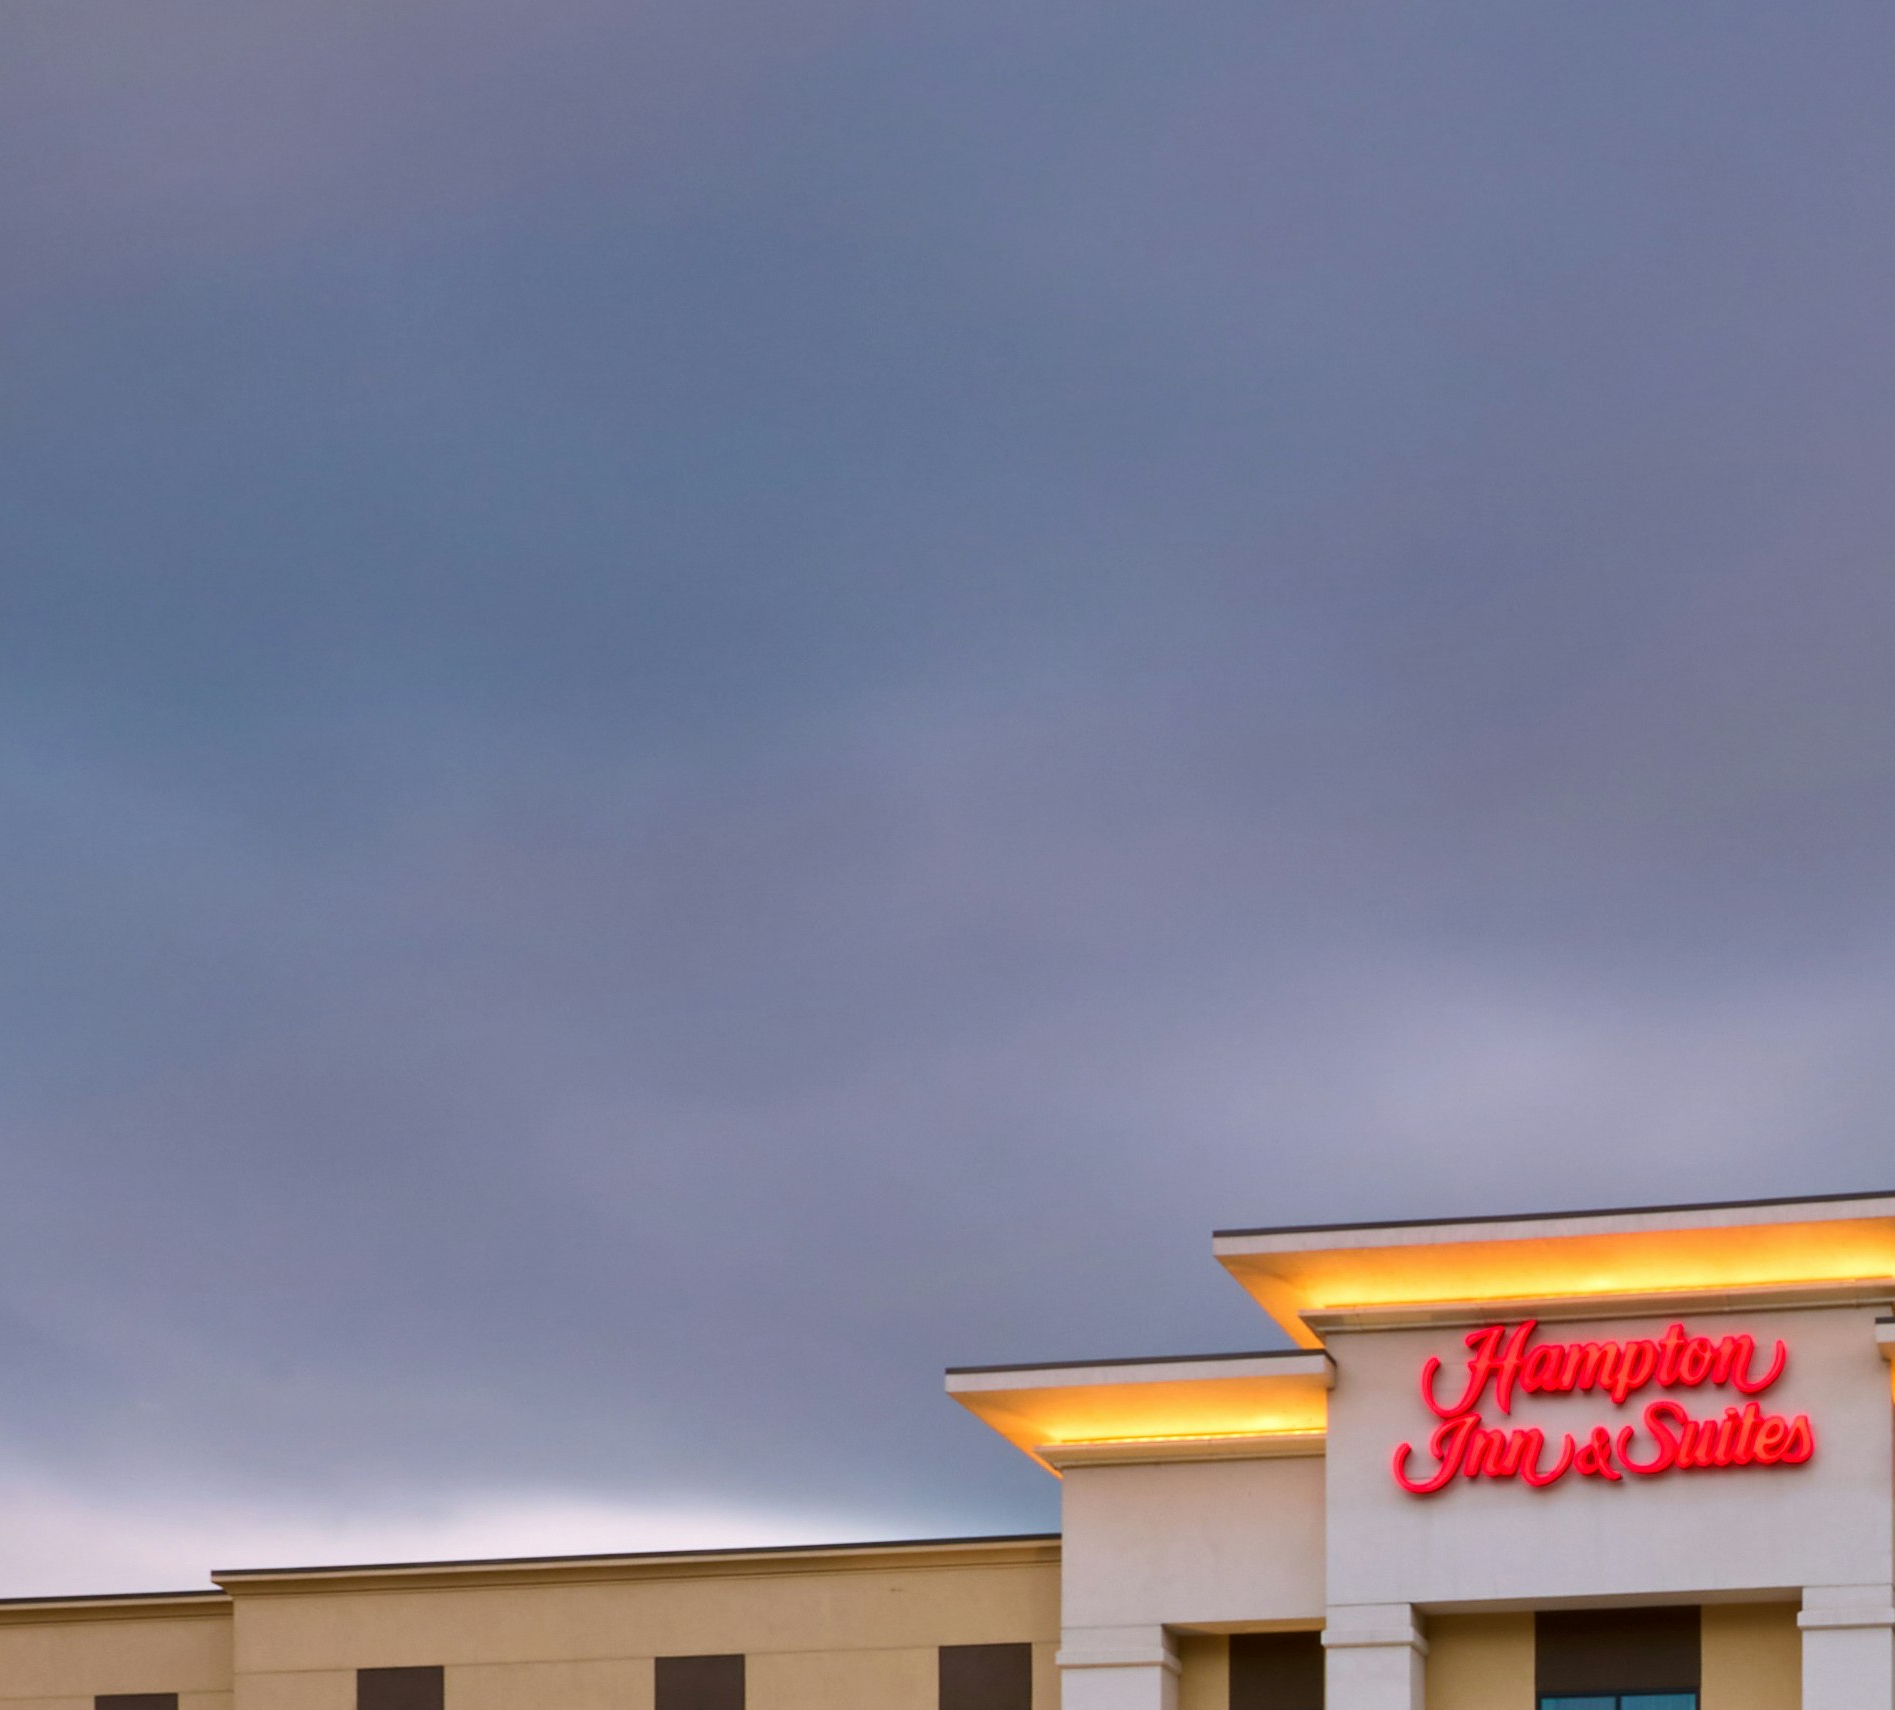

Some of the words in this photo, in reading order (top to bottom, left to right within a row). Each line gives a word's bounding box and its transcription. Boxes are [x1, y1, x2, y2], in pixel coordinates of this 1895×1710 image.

[1421, 1319, 1787, 1417] Hampton
[1392, 1412, 1575, 1494] Inn
[1573, 1425, 1623, 1480] &
[1616, 1400, 1815, 1474] Suites
